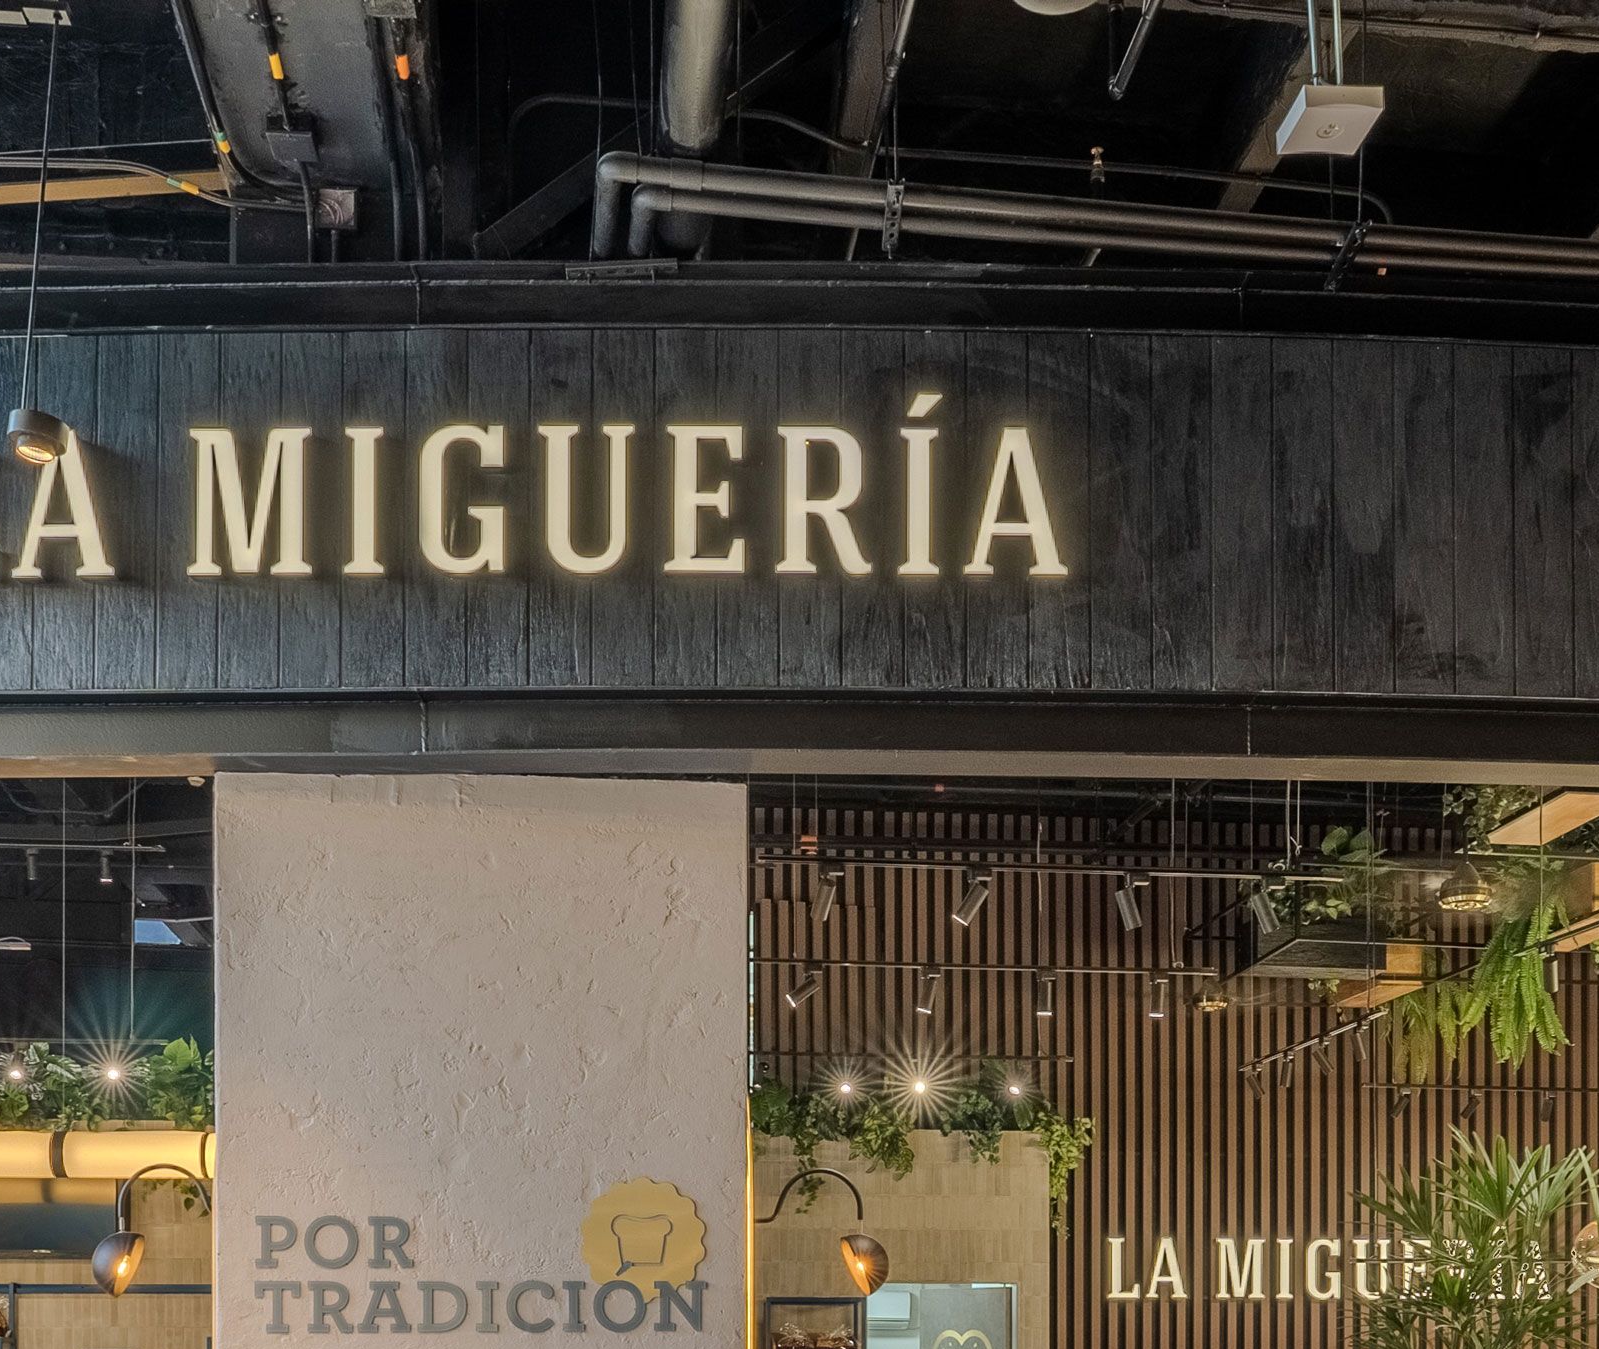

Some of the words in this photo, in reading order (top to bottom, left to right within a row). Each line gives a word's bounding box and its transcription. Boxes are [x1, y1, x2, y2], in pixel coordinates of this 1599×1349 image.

[184, 391, 1071, 578] MIGUERÍA
[254, 1215, 415, 1269] POR
[1106, 1236, 1189, 1300] LA
